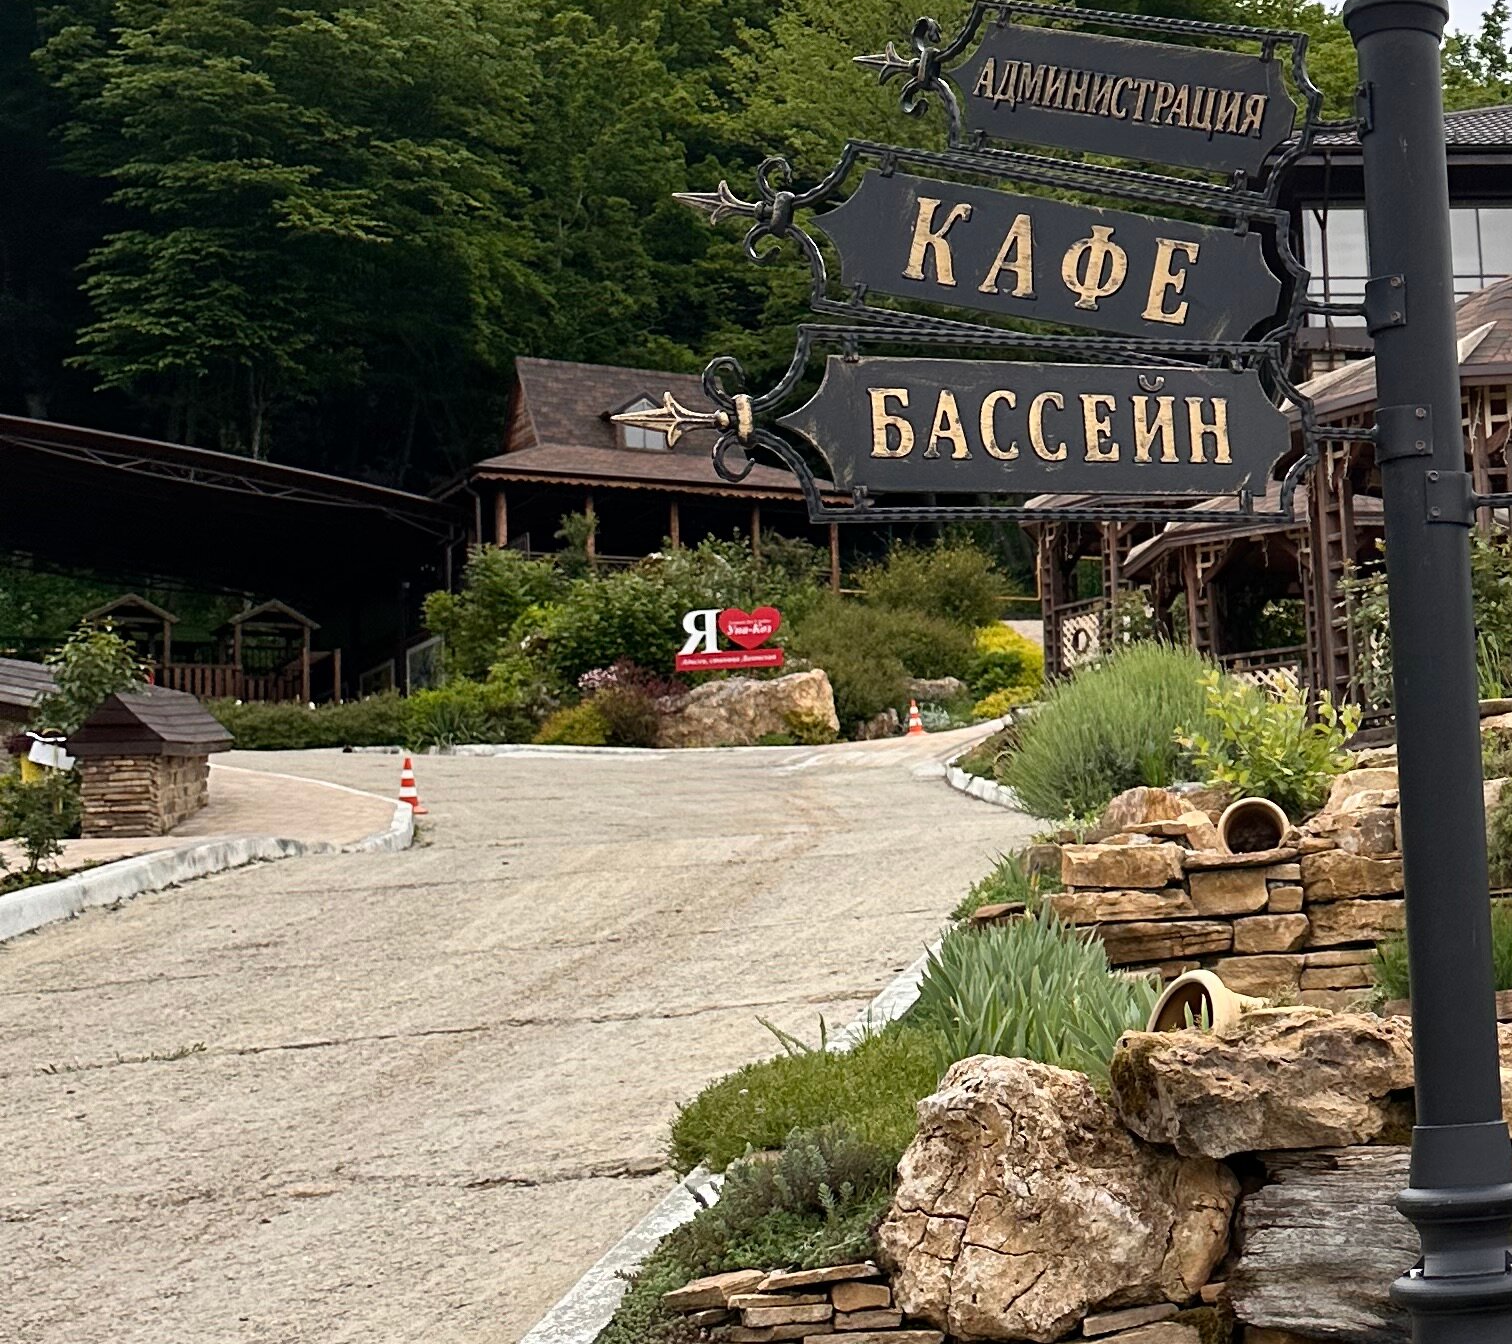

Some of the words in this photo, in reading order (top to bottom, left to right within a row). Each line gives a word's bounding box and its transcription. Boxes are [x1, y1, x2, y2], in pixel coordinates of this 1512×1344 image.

[972, 56, 1268, 140] АДМИНИСТРАЦИЯ
[901, 196, 1200, 325] КАФЕ
[866, 374, 1233, 465] БАССЕЙН
[677, 608, 724, 656] Я
